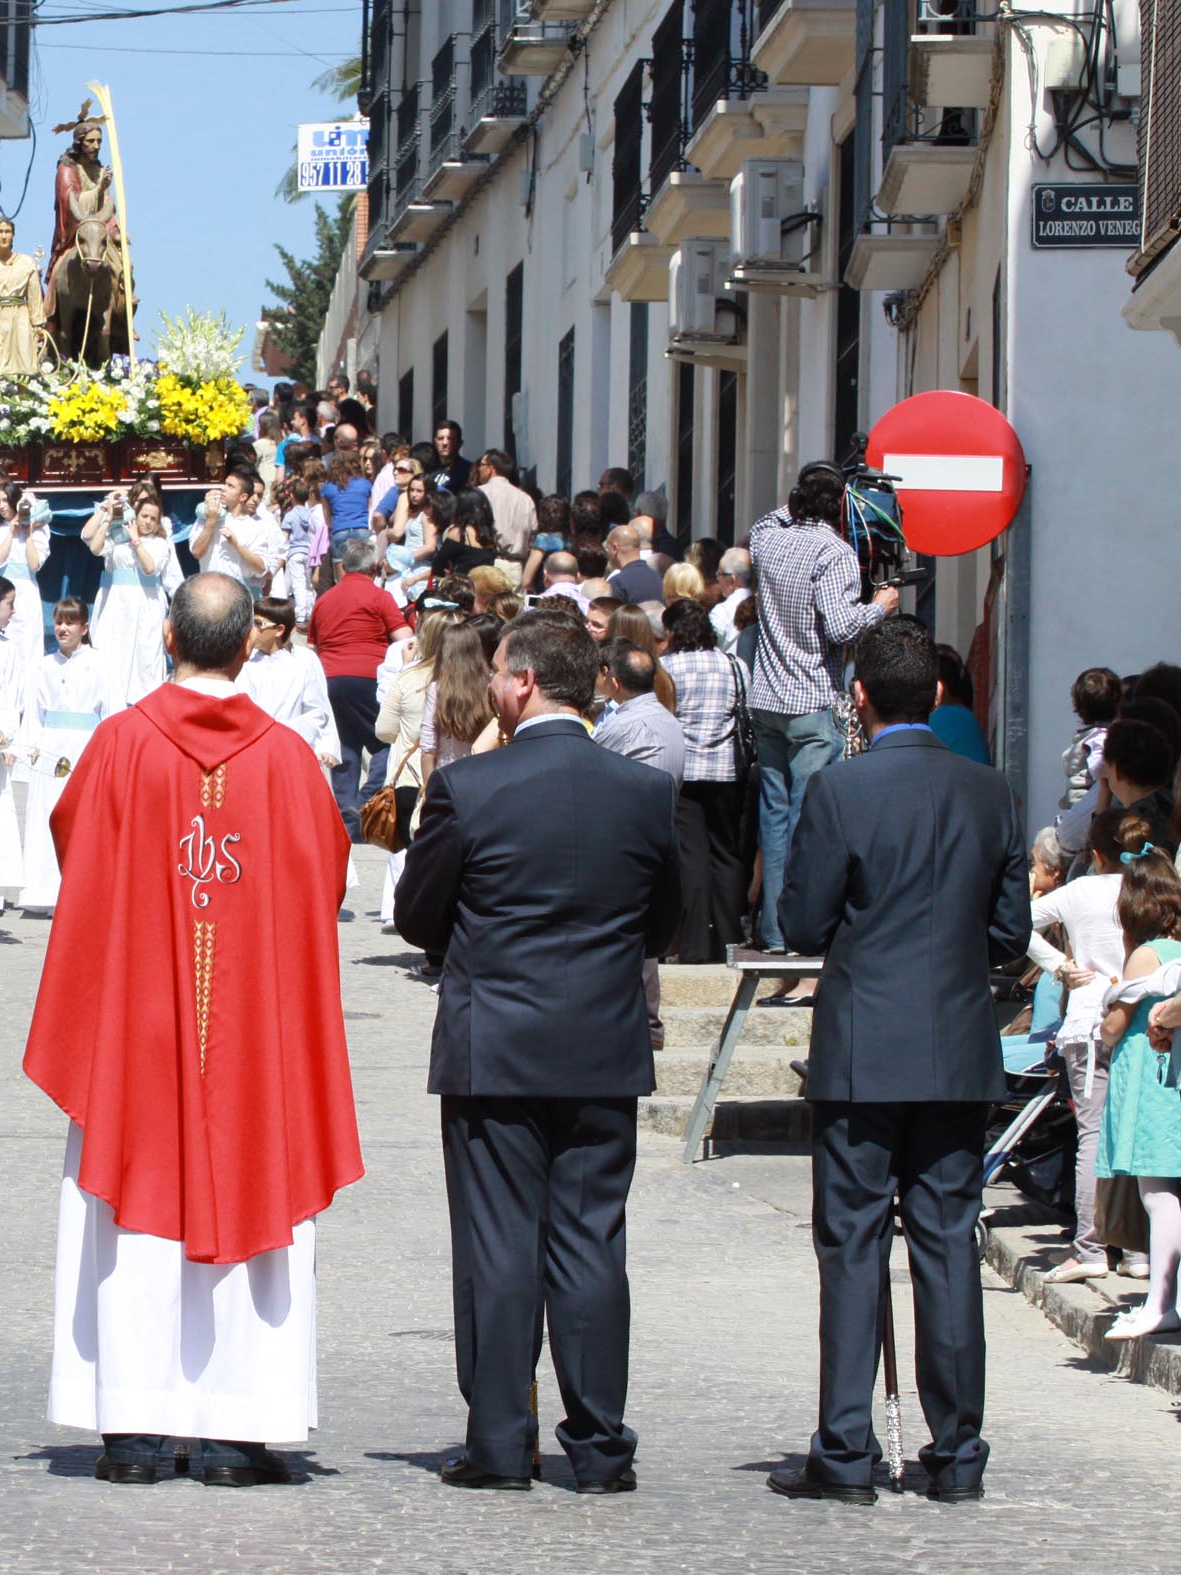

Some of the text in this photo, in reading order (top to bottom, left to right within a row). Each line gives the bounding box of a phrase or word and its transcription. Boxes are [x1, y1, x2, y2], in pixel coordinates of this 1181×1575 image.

[302, 162, 324, 186] 957
[328, 162, 342, 185] 11
[346, 161, 361, 185] 28
[1061, 196, 1133, 212] CALLE
[1038, 220, 1096, 236] LORENZO
